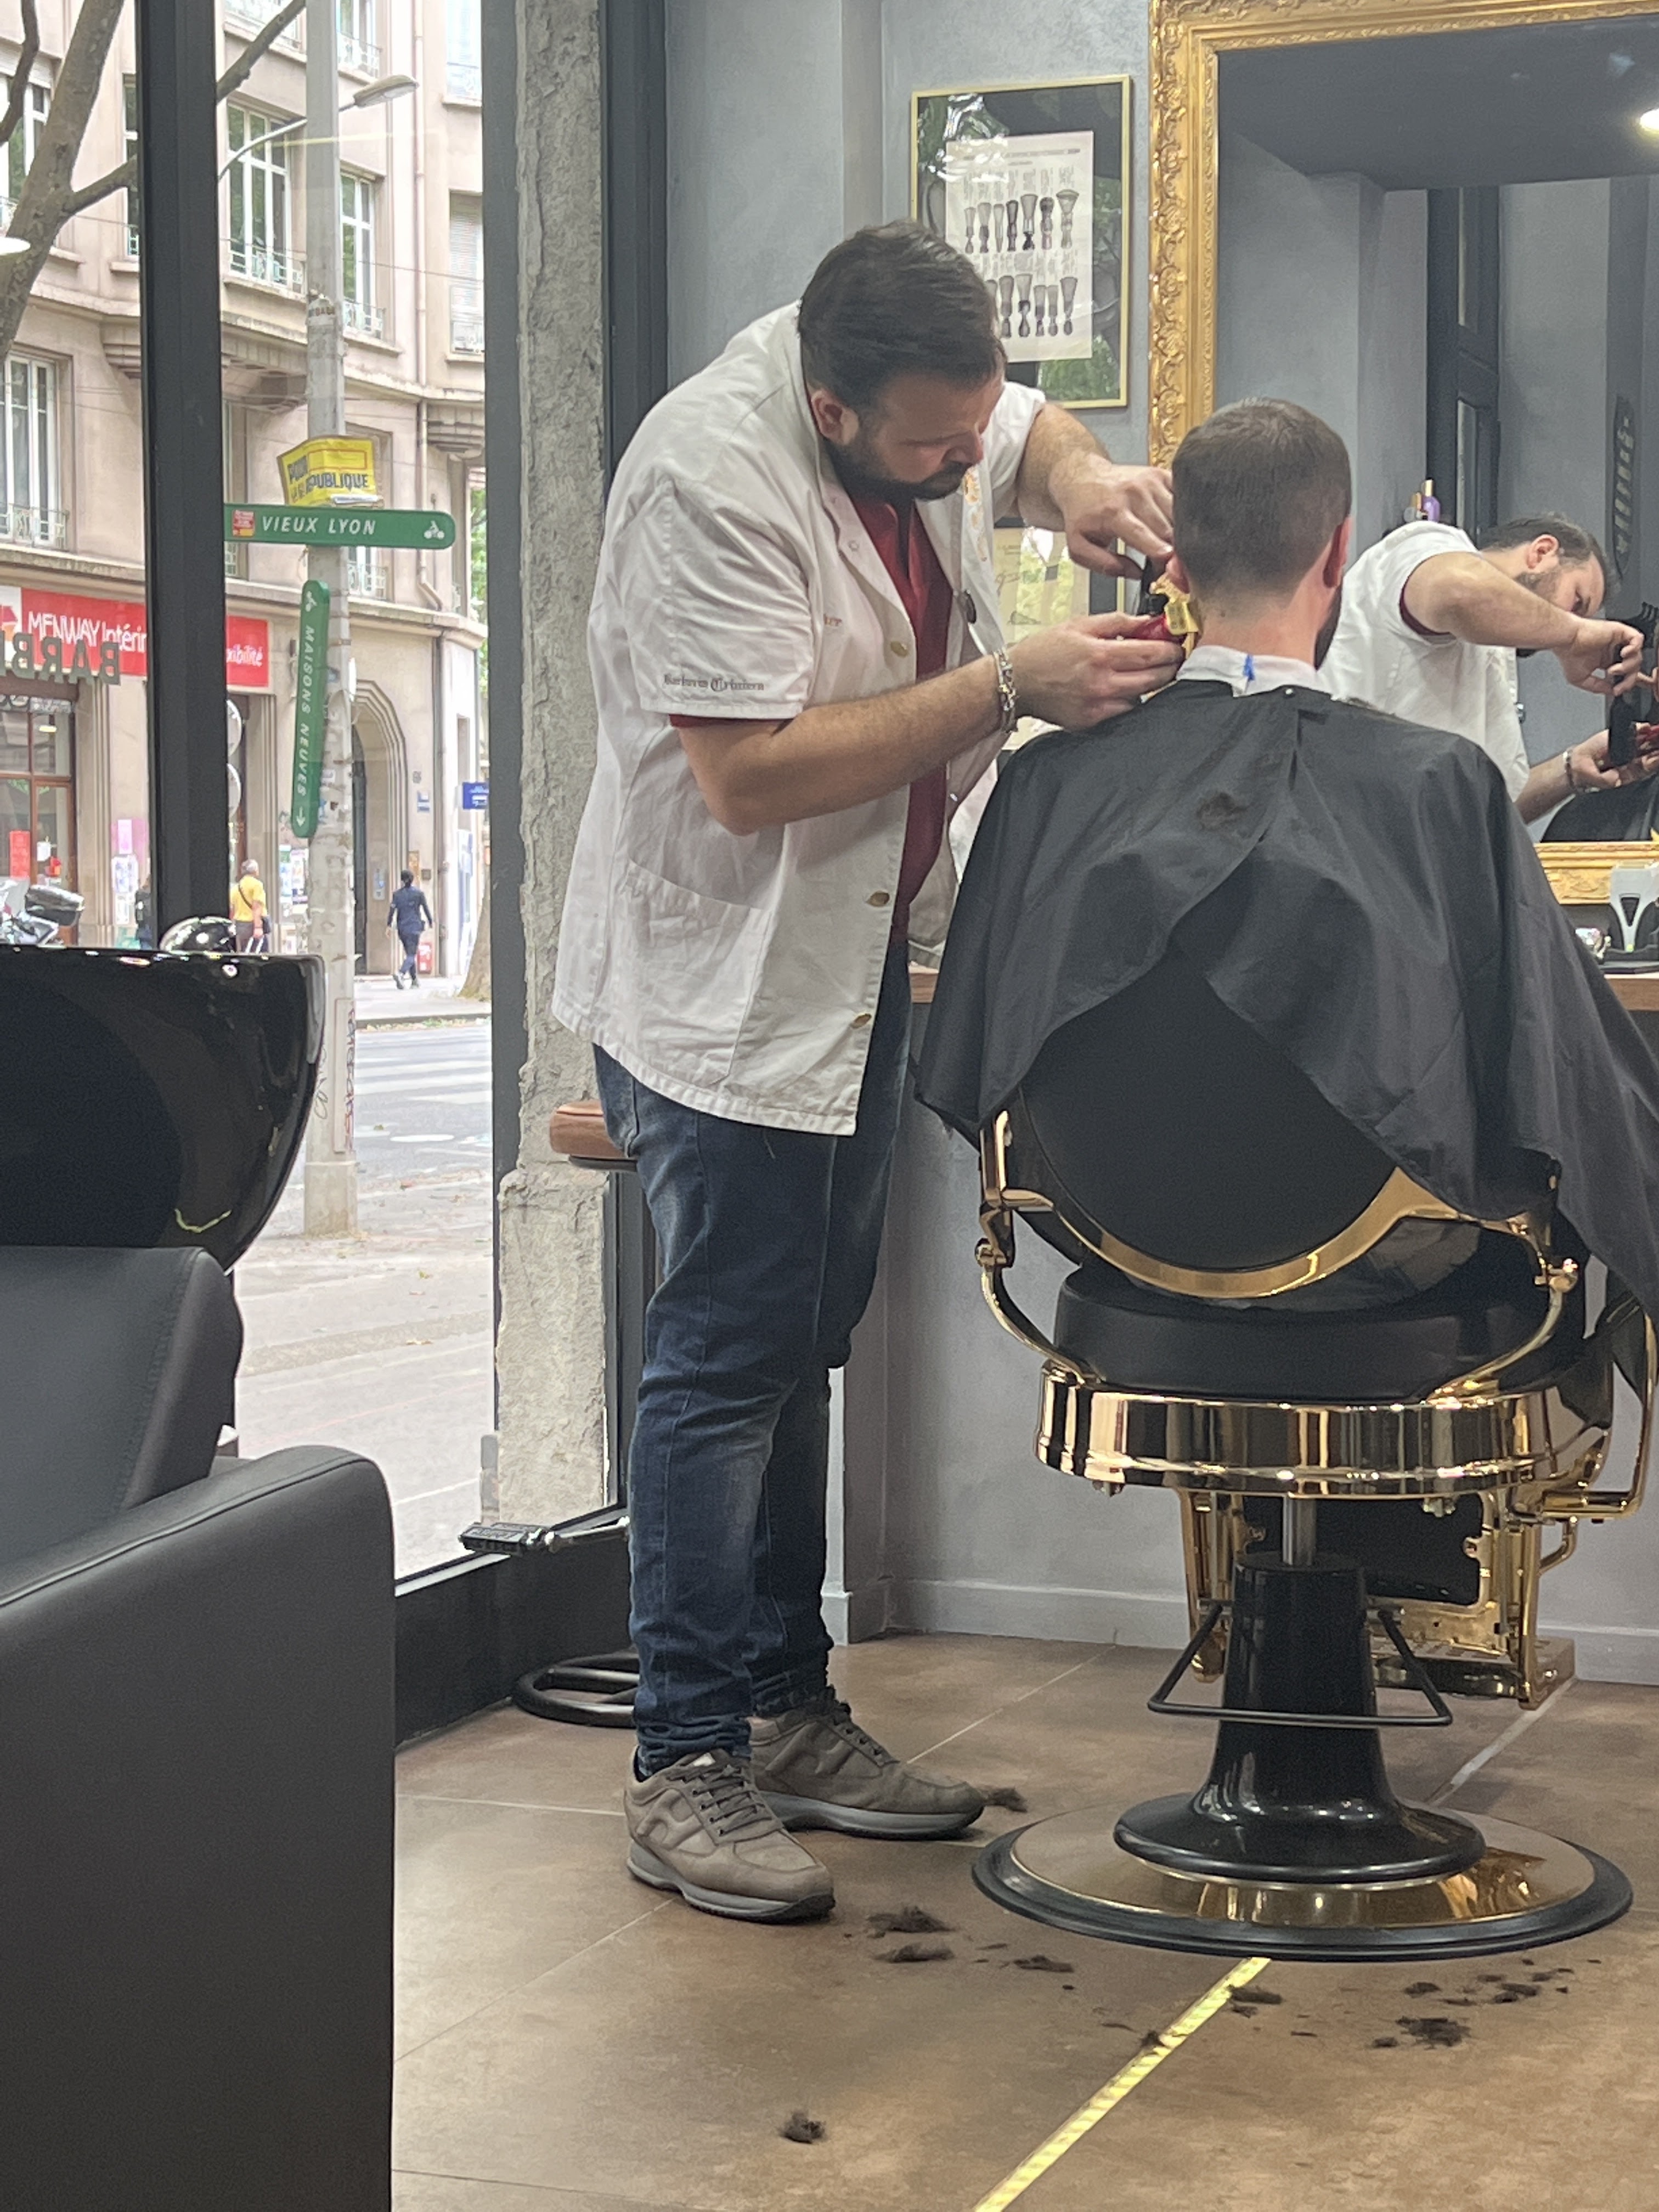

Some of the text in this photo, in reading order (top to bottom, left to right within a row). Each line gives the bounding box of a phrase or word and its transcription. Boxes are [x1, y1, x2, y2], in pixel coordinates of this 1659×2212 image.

[262, 516, 319, 534] VIEUX
[328, 518, 376, 535] LYON
[297, 624, 315, 797] MAISONS NEUVES
